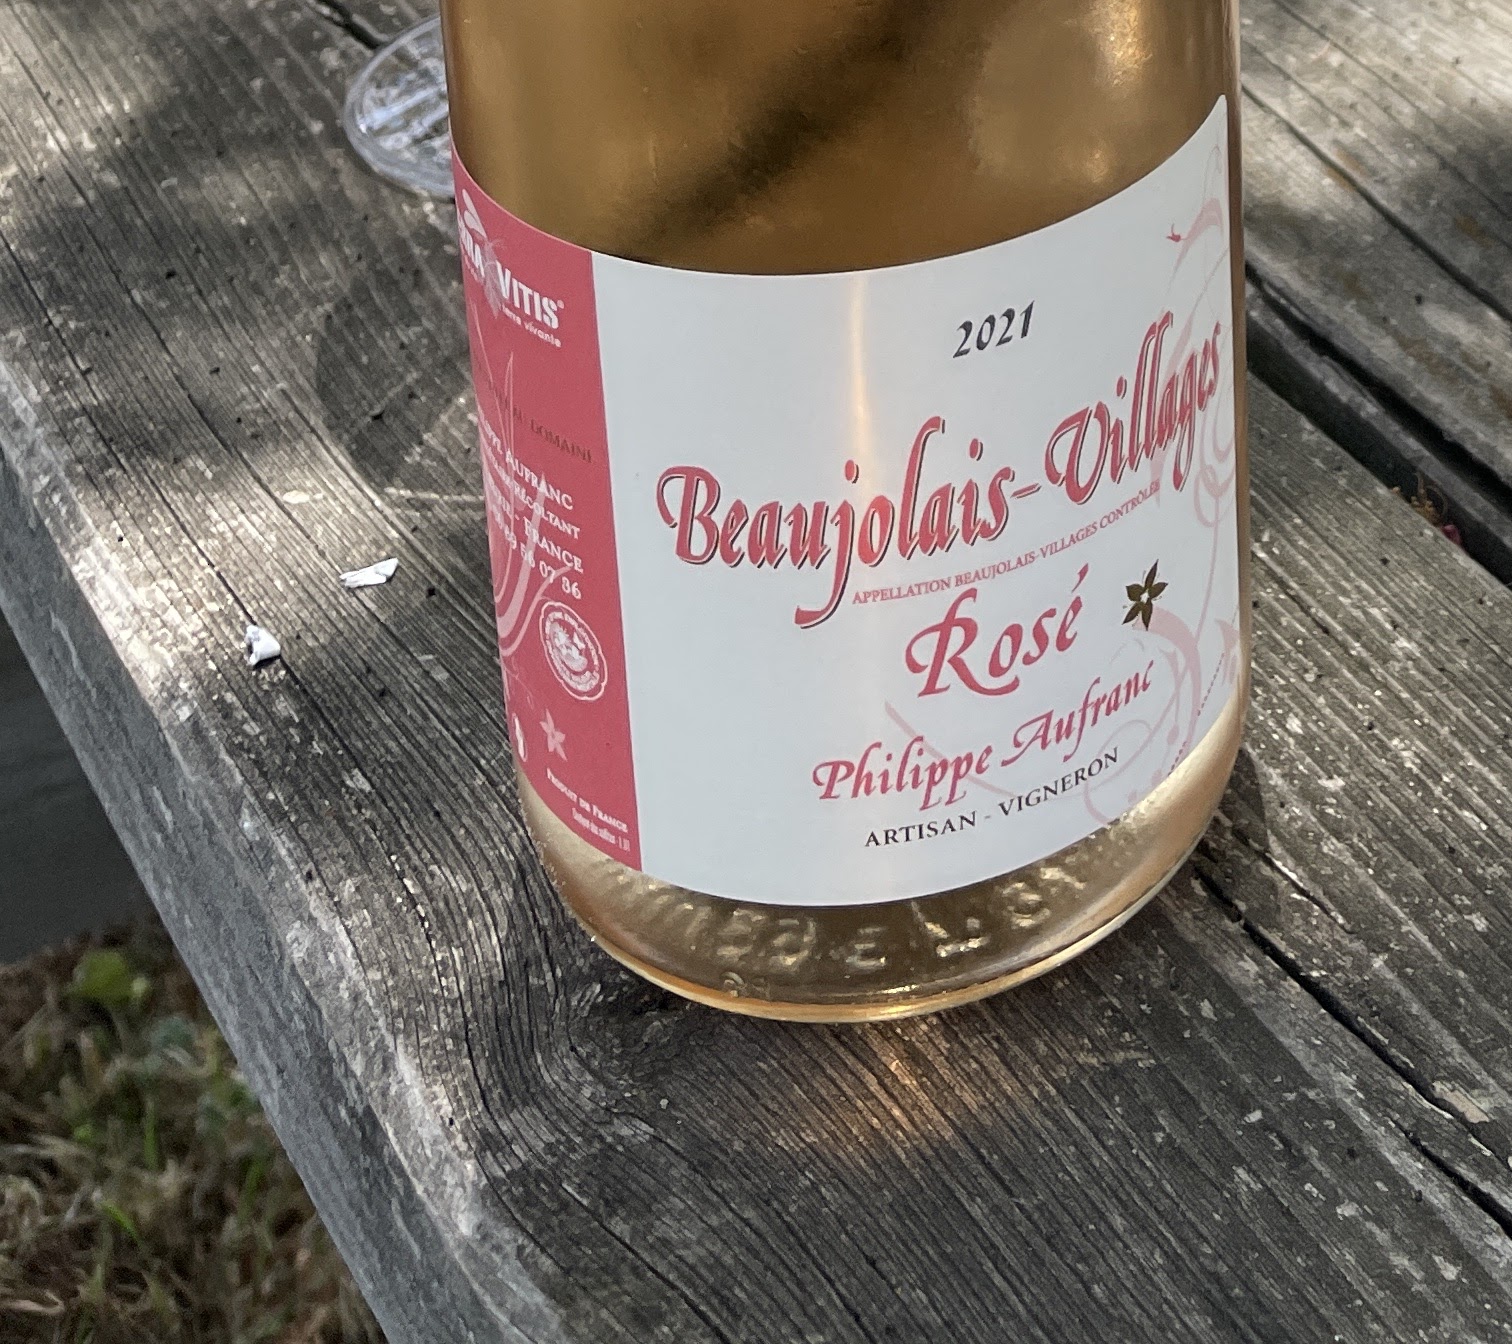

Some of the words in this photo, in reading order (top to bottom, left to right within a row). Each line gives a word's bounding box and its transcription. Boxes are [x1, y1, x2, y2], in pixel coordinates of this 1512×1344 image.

[496, 259, 560, 330] VITIS
[953, 299, 1036, 359] 2021
[506, 448, 574, 511] AUFRANC
[656, 310, 1221, 629] Beaujolais-Villages
[523, 515, 584, 575] FRANCE
[539, 560, 555, 584] 07
[852, 576, 951, 605] APPELLATION
[954, 521, 1099, 589] BEAUJOLAIS-VILLAGES
[904, 562, 1091, 699] Rosé
[811, 735, 994, 812] Philippe
[1000, 659, 1156, 768] Aufranc
[864, 809, 978, 848] ARTISAN
[997, 746, 1120, 817] VIGNERON
